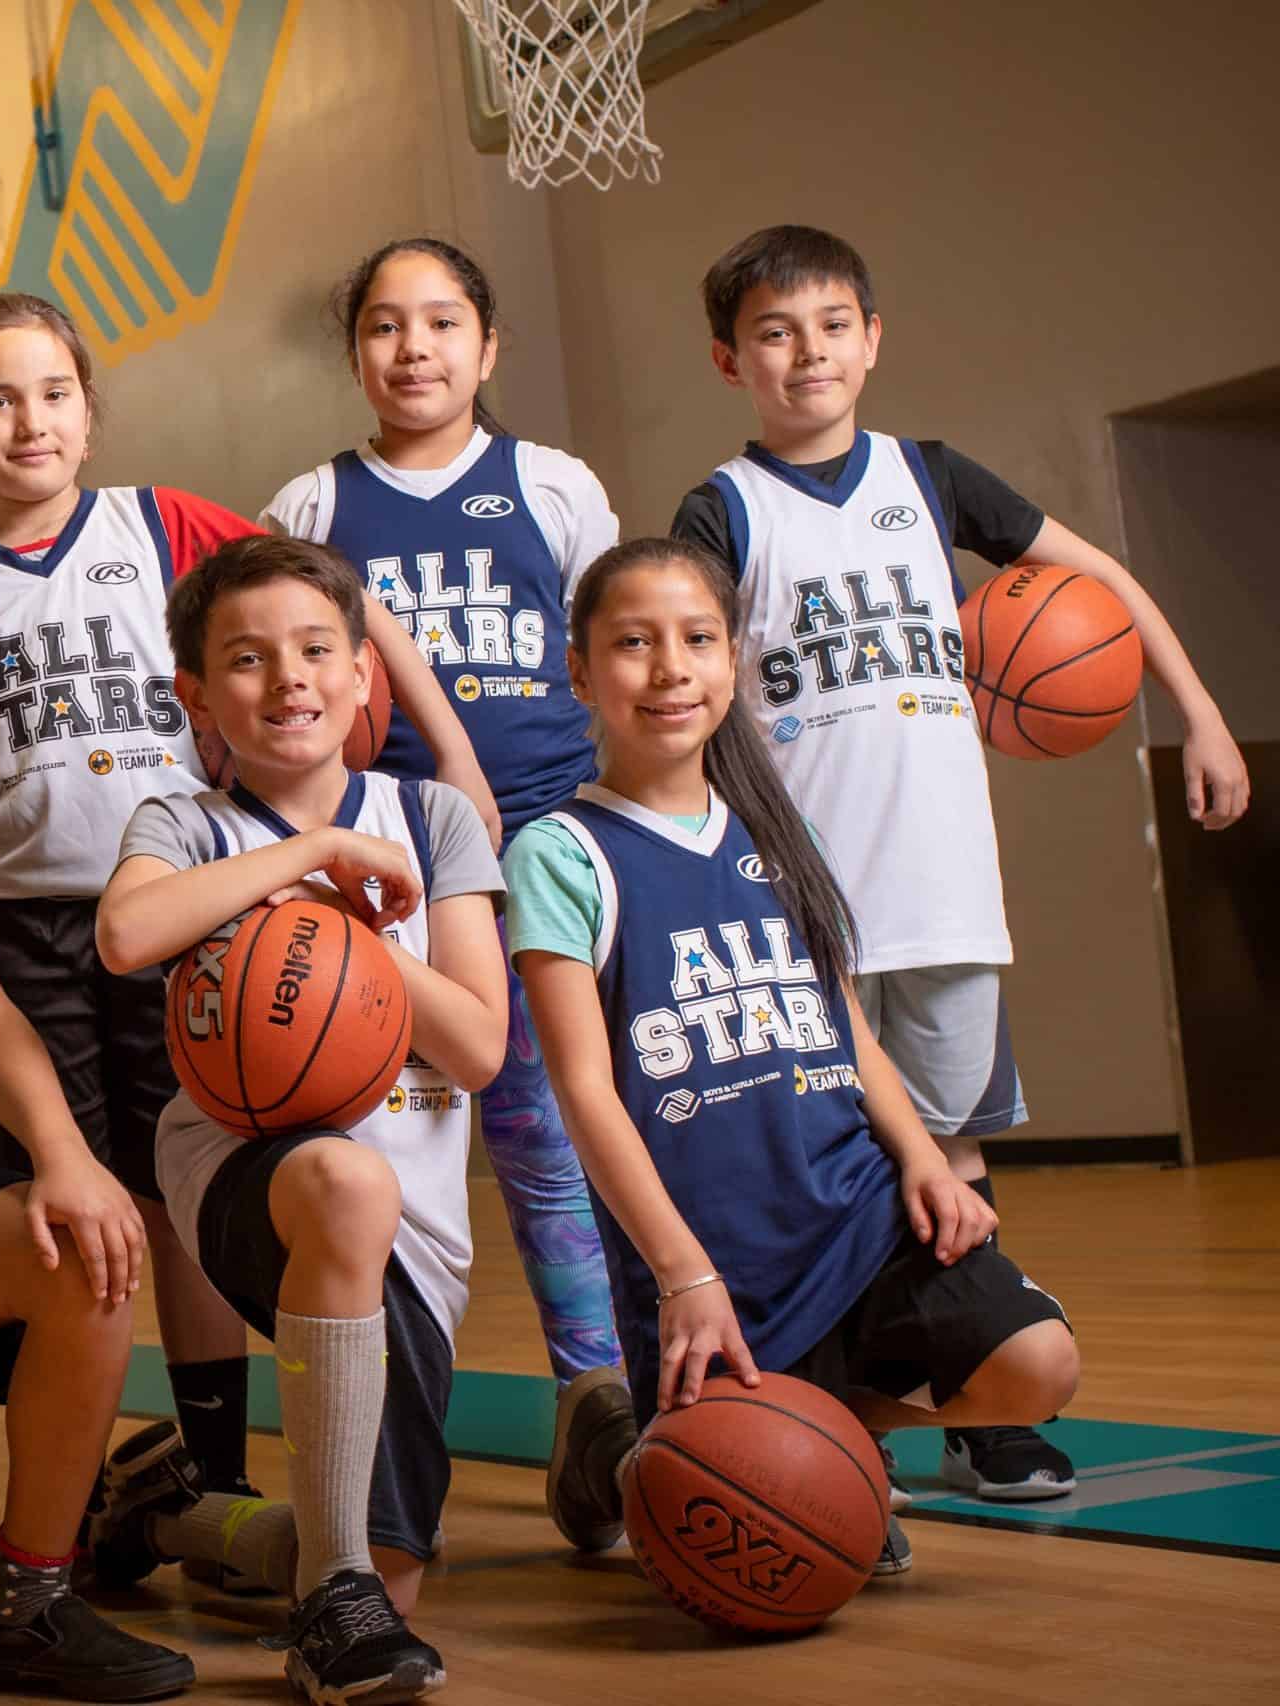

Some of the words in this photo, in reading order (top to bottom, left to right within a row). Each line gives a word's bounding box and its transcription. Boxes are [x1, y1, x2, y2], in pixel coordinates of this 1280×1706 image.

[366, 548, 511, 613] ALL
[790, 564, 934, 639] ALL
[759, 622, 964, 708] STARS
[922, 701, 942, 716] TEAM
[118, 754, 148, 770] TEAM
[150, 752, 163, 768] UP
[267, 916, 321, 1030] molten
[670, 918, 817, 1001] ALL
[409, 1096, 432, 1112] TEAM
[808, 1073, 841, 1092] TEAM
